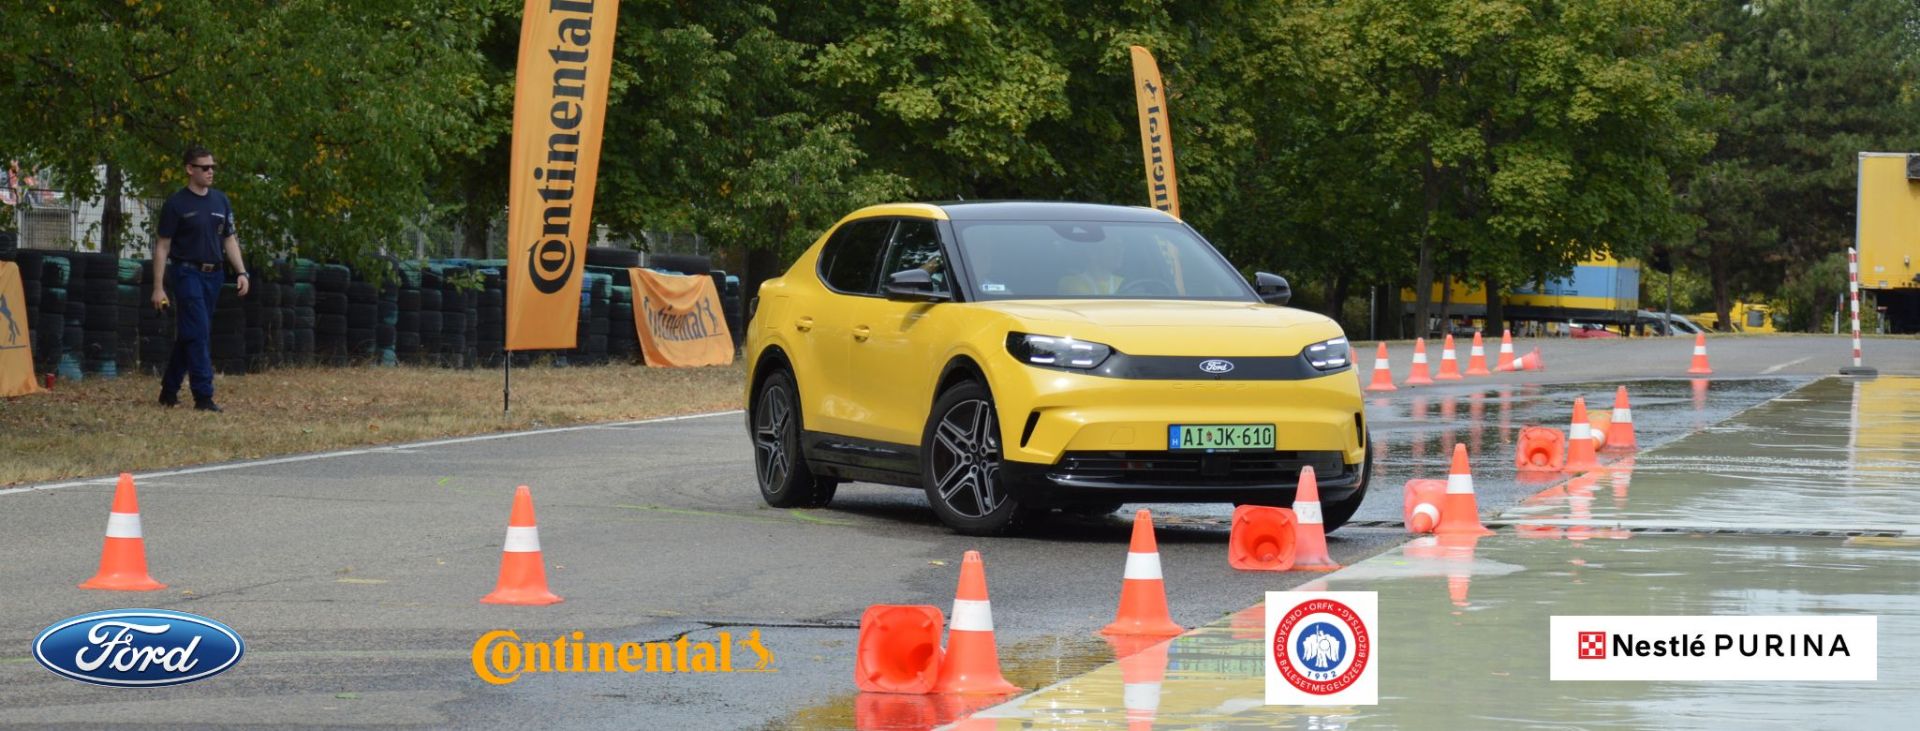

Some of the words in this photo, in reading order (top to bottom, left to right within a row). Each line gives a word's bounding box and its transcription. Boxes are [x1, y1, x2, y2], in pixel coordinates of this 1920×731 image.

[527, 0, 595, 294] Continental
[1206, 361, 1228, 371] Ford
[1183, 427, 1204, 446] AI
[1214, 427, 1272, 446] JK-610
